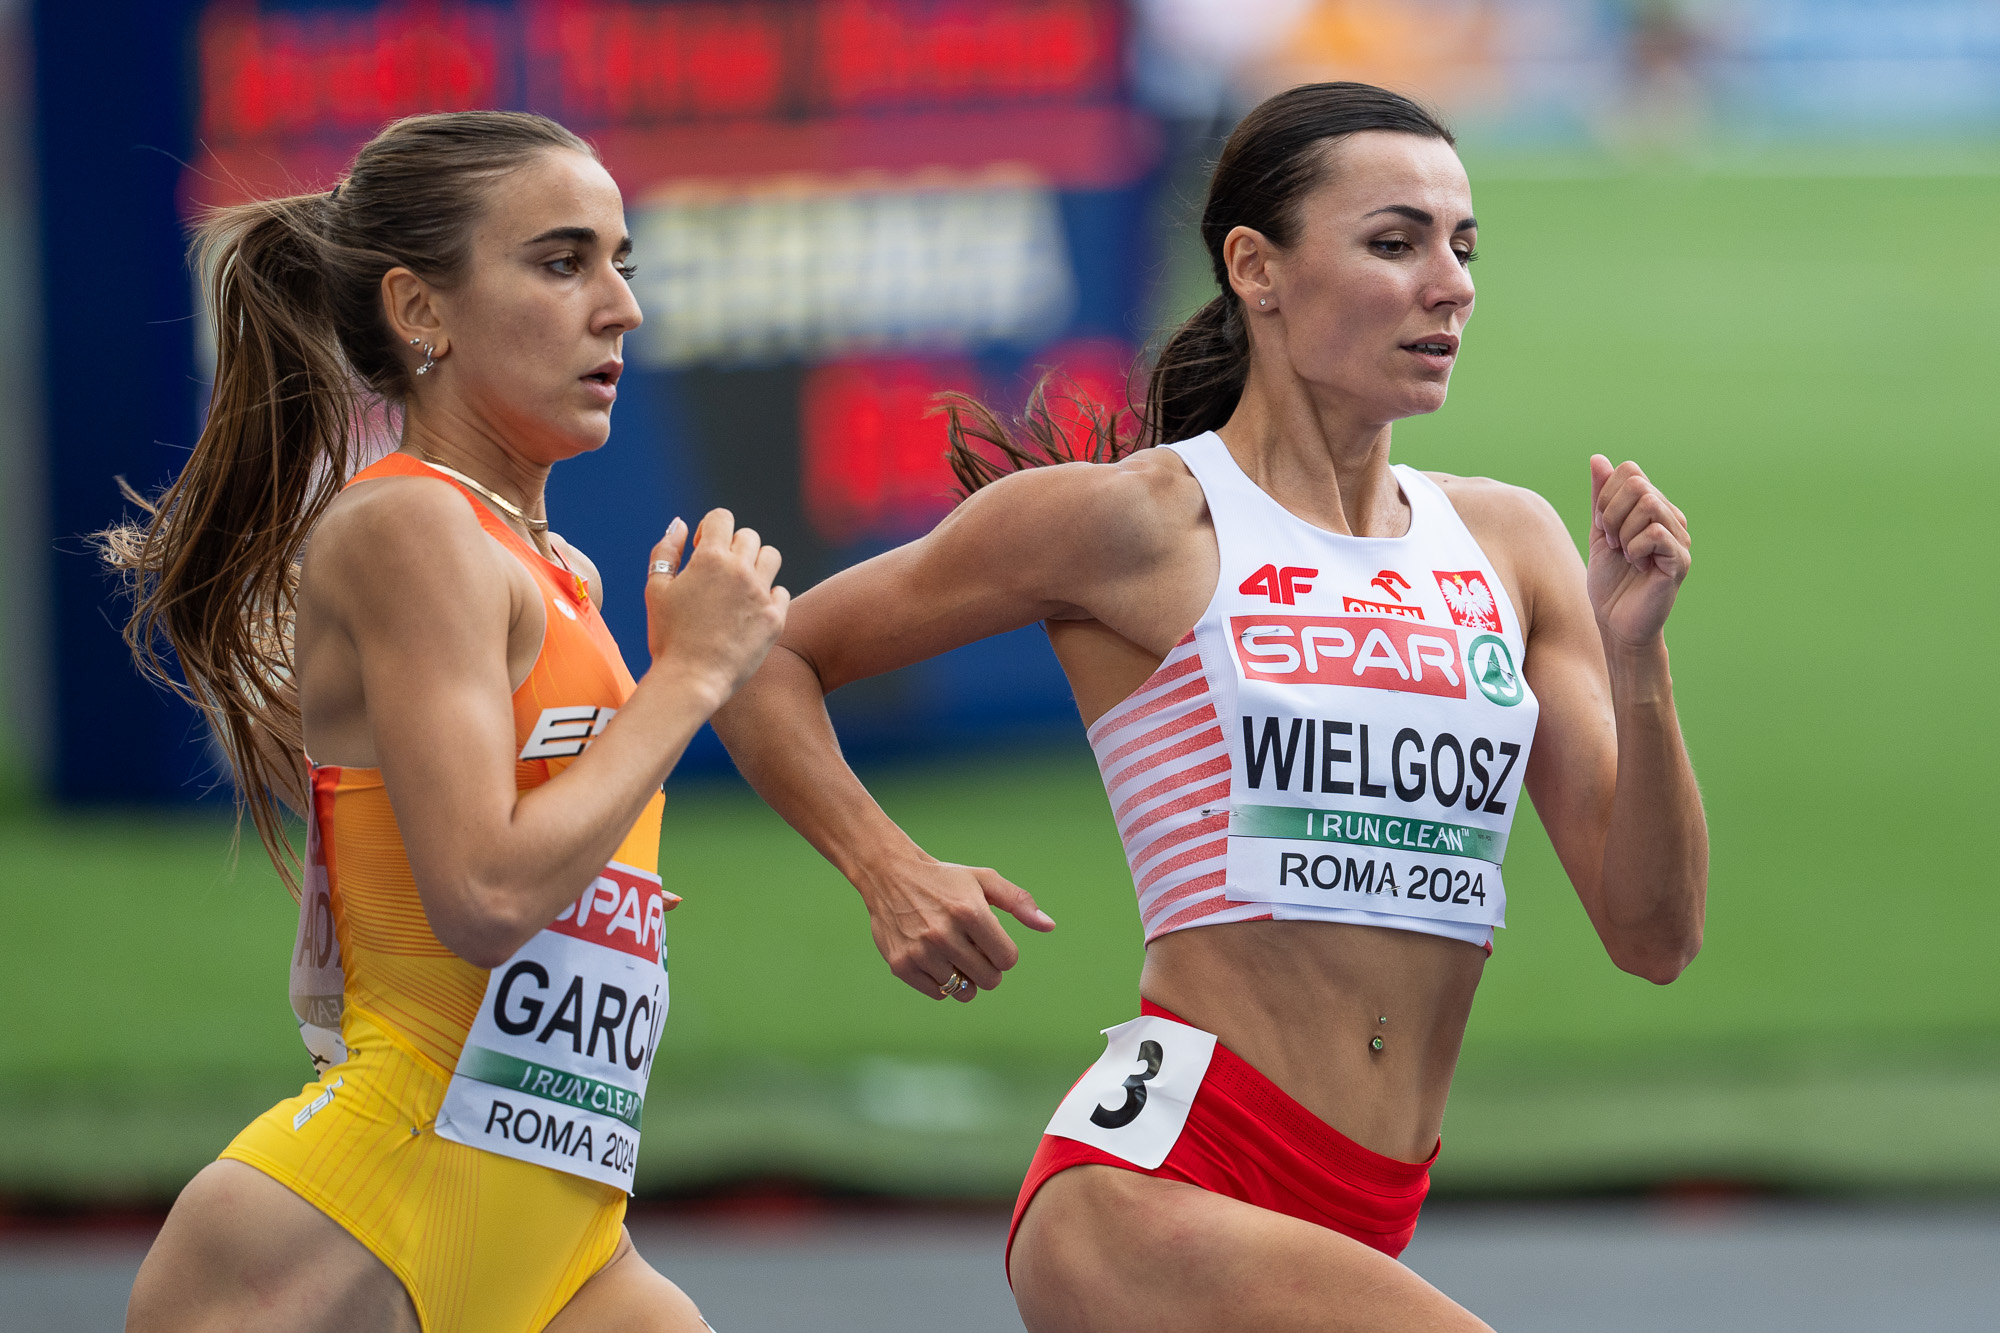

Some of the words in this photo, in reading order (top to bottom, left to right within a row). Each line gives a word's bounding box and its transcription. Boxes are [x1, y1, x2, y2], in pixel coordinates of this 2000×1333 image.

[1239, 563, 1319, 605] 4F
[1241, 626, 1461, 687] SPAR
[1242, 715, 1521, 815] WIELGOSZ
[1306, 812, 1314, 836] I
[1322, 814, 1381, 842] RUN
[1279, 852, 1398, 897] ROMA
[1406, 865, 1486, 907] 2024
[519, 1065, 532, 1088] I
[531, 1069, 590, 1105] RUN
[1089, 1040, 1163, 1129] 3
[484, 1100, 593, 1164] ROMA
[600, 1132, 635, 1177] 2024
